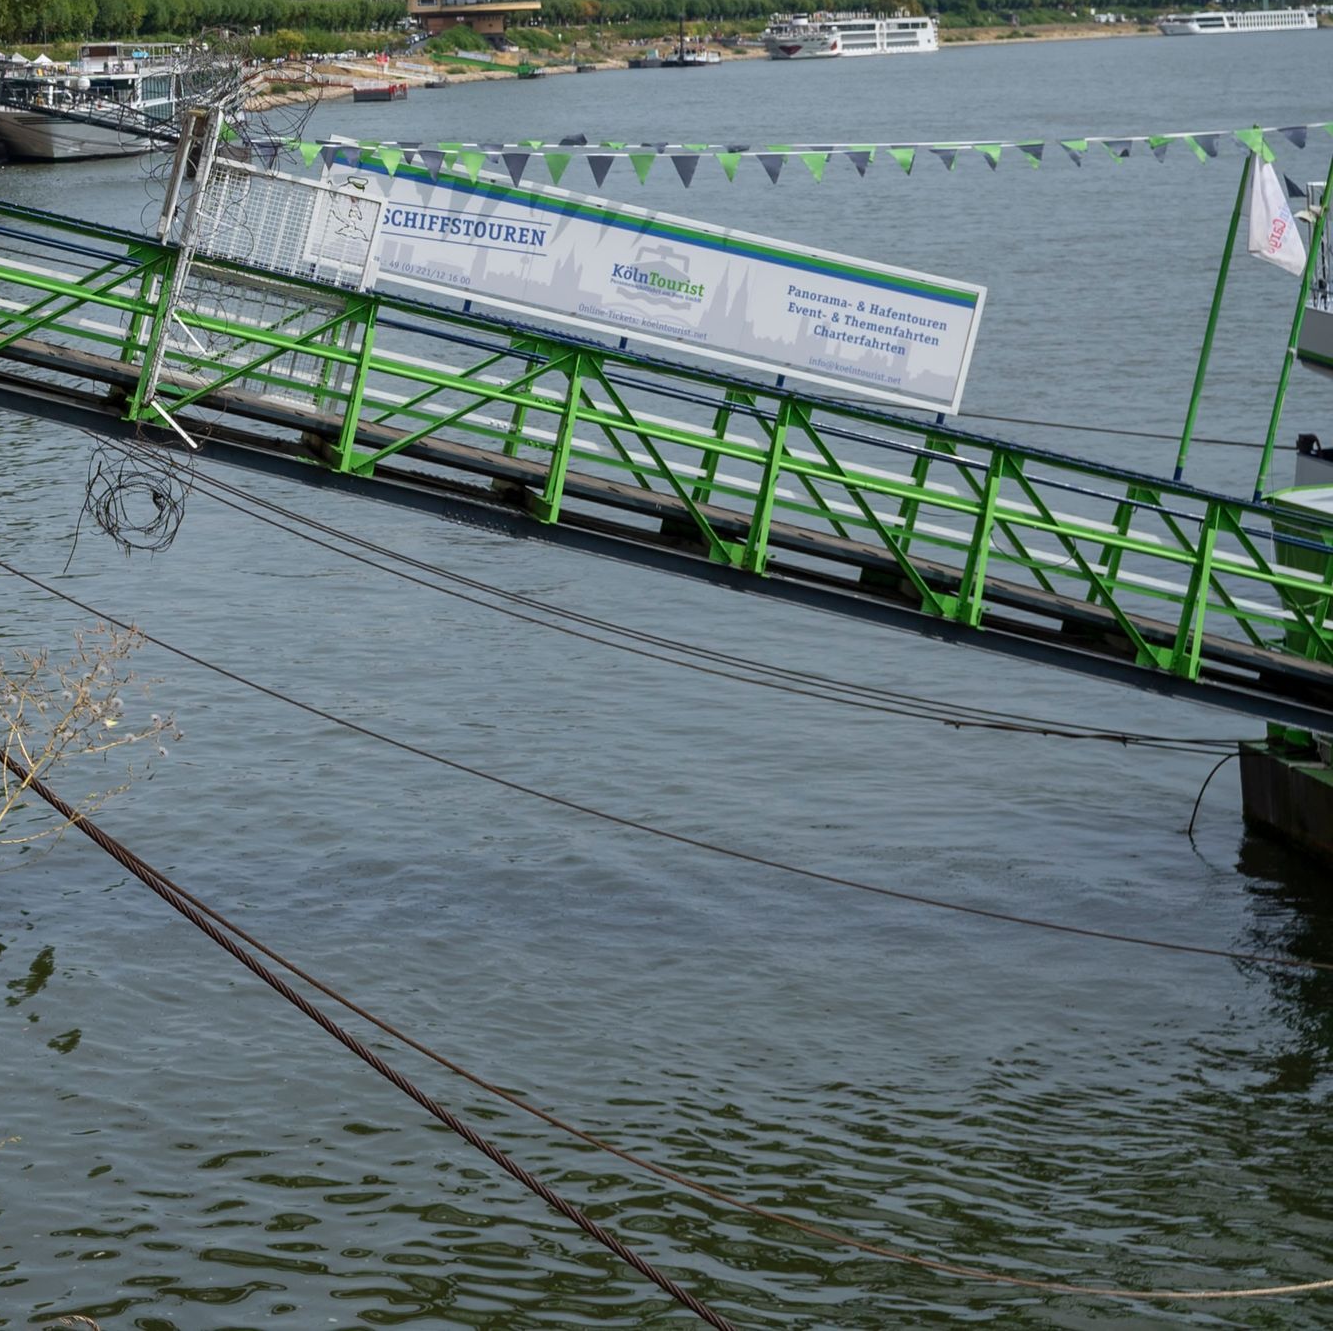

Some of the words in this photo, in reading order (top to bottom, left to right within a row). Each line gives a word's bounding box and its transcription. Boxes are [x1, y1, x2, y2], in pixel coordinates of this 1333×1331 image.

[383, 208, 546, 246] SCHIFFSTOUREN
[402, 262, 414, 273] (0)
[417, 265, 446, 281] 221/12
[448, 273, 458, 283] 16
[461, 276, 471, 285] 00
[612, 263, 705, 297] KölnTourist
[578, 304, 639, 325] Online-Tickets:
[641, 318, 707, 340] koelntourist.net
[788, 285, 853, 309] Panorama-
[857, 301, 865, 312] &
[869, 304, 947, 331] Hafentouren
[788, 302, 827, 319] Event-
[831, 312, 840, 323] &
[844, 315, 939, 346] Themenfahrten
[813, 325, 906, 356] Charterfahrten
[808, 356, 902, 385] info@koelntourist.net
